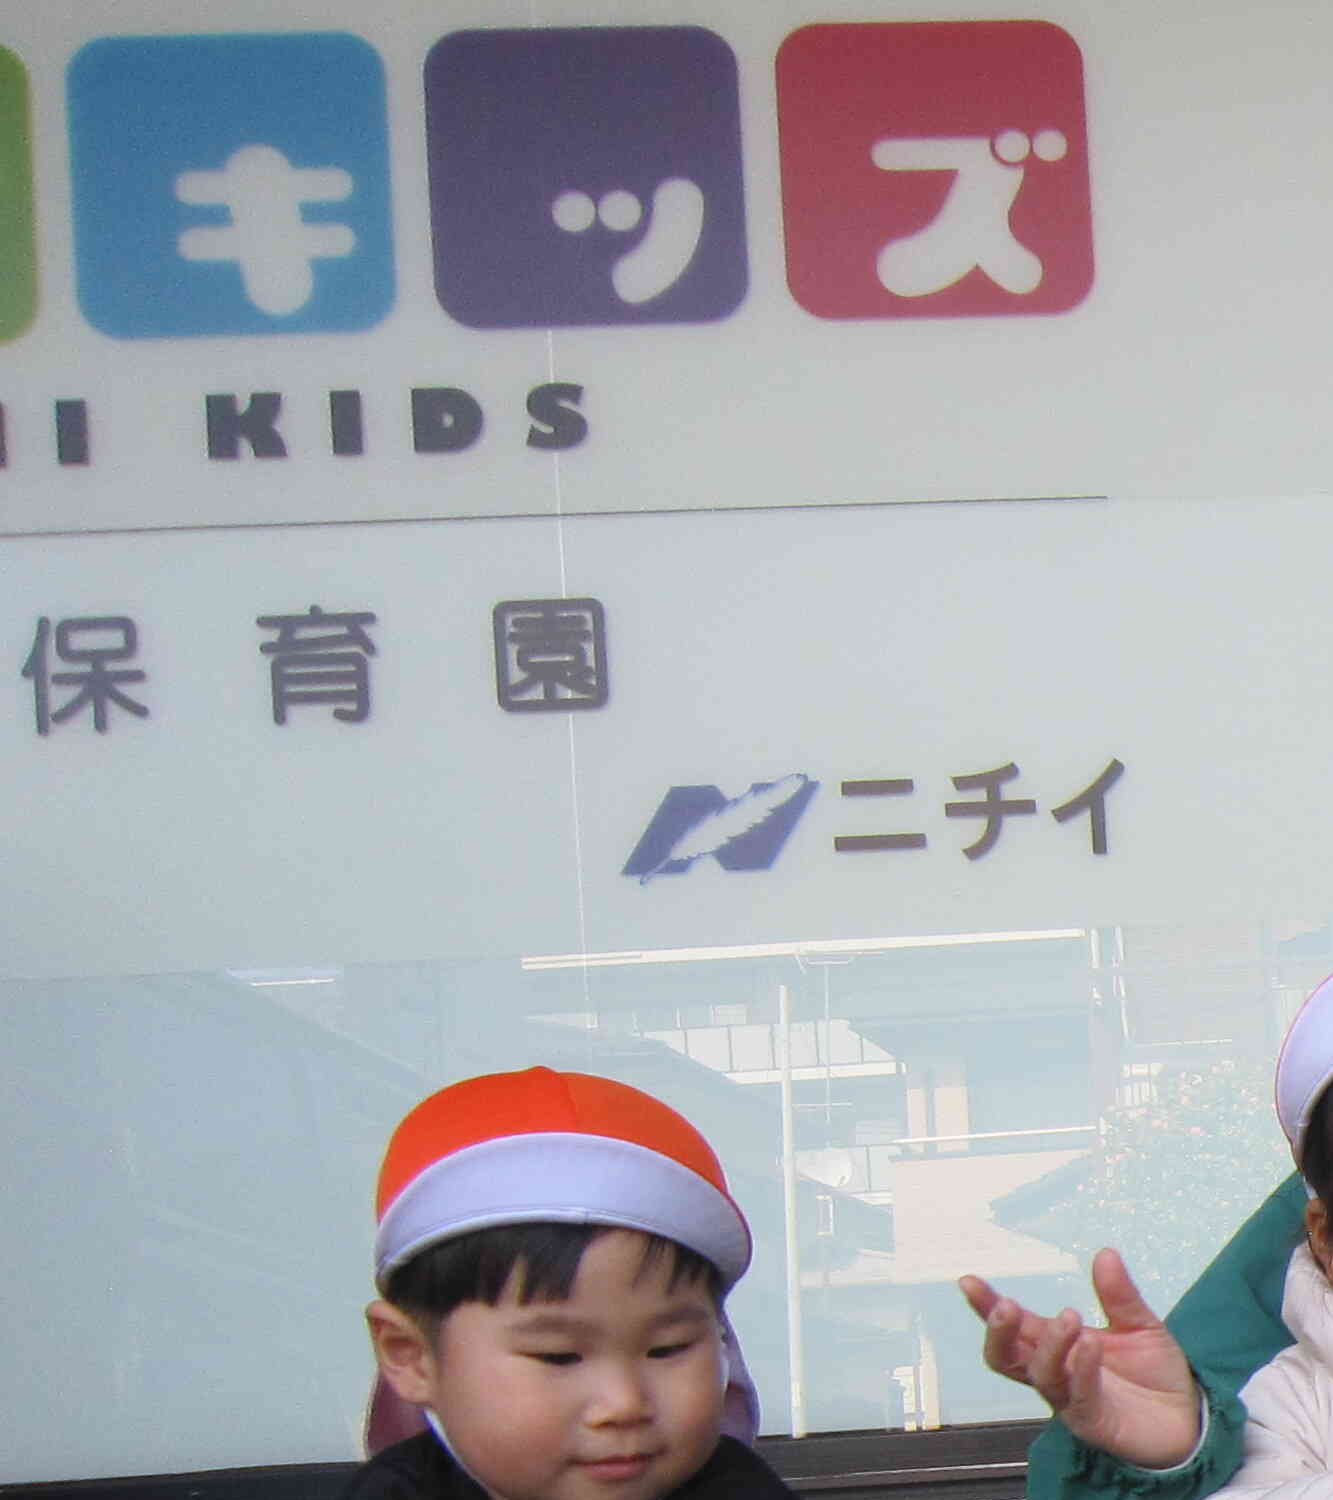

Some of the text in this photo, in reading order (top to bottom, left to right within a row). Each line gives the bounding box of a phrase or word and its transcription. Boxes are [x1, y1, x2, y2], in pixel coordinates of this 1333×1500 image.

[177, 130, 1068, 316] キッズ
[205, 383, 590, 462] KIDS
[21, 598, 611, 737] 保育園
[833, 758, 1126, 861] ニチイ
